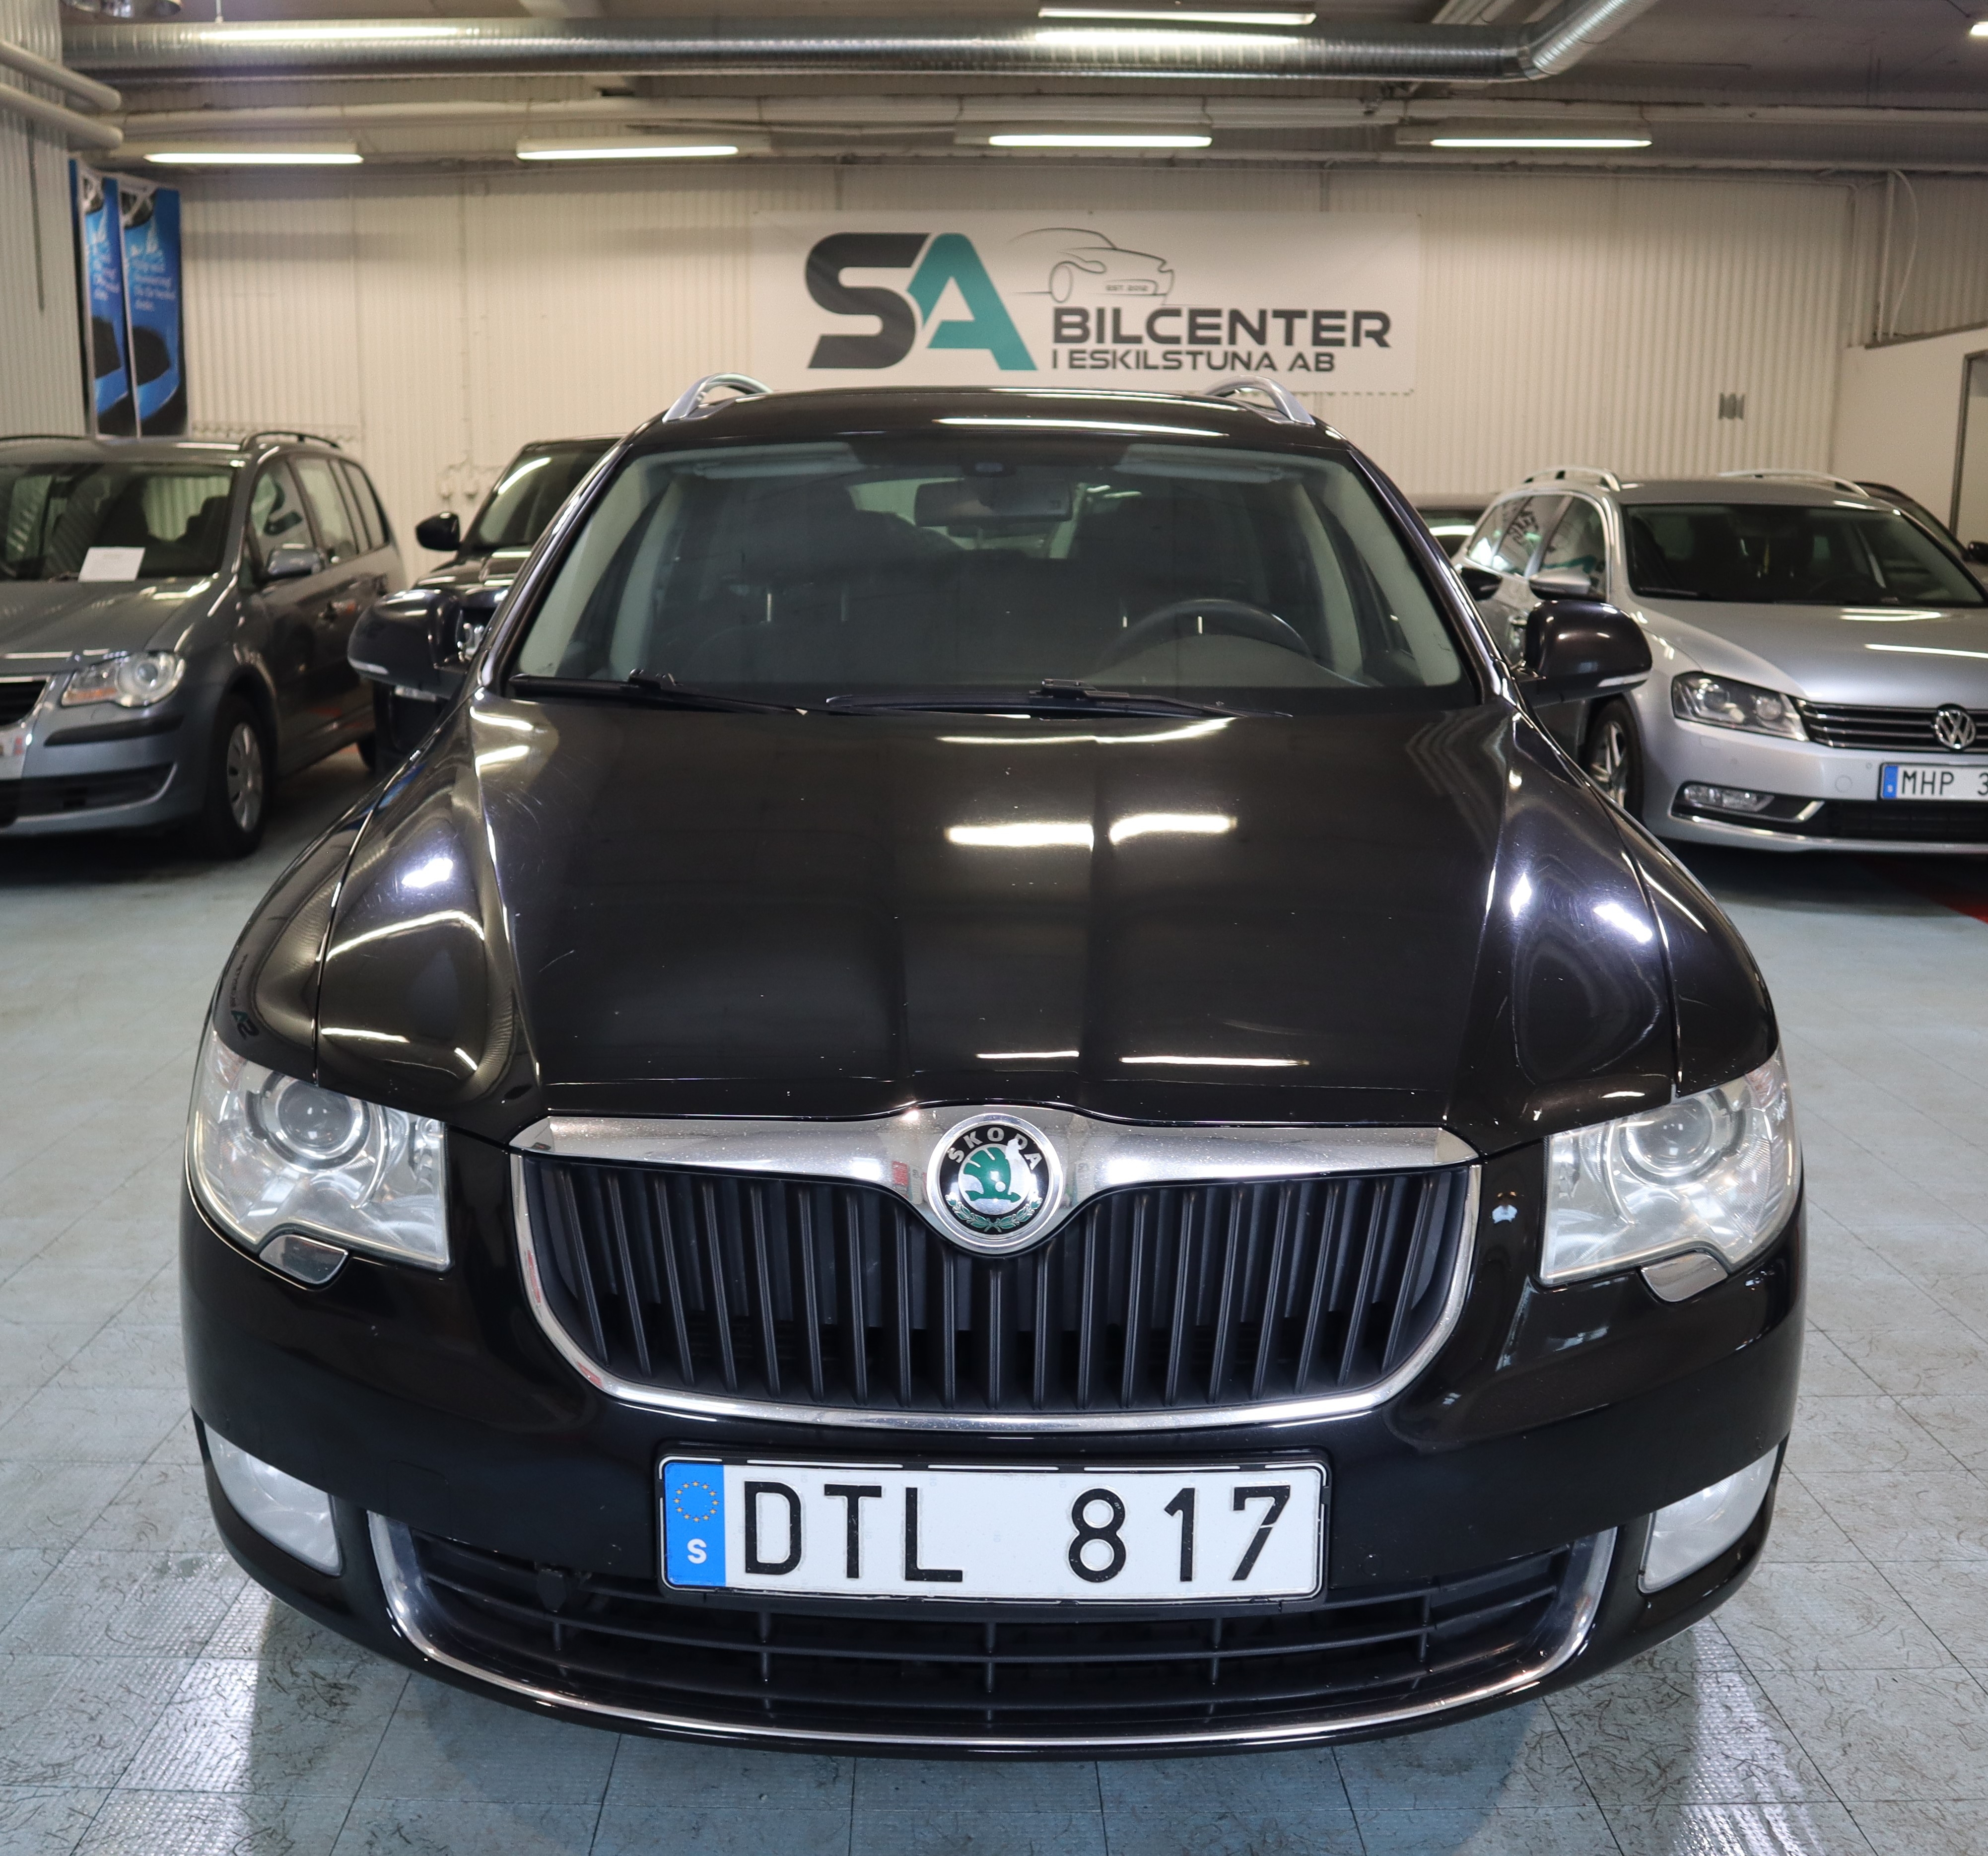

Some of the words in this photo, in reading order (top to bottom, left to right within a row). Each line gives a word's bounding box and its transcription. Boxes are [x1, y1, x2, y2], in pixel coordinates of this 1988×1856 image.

[804, 232, 1038, 371] SA
[1053, 307, 1392, 347] BILCENTER
[1069, 349, 1277, 371] ESKILSTUNA
[1288, 351, 1334, 372] AB
[1902, 770, 1954, 795] MHP
[744, 1480, 963, 1582] DTL
[1068, 1485, 1291, 1582] 817
[687, 1538, 707, 1564] S
